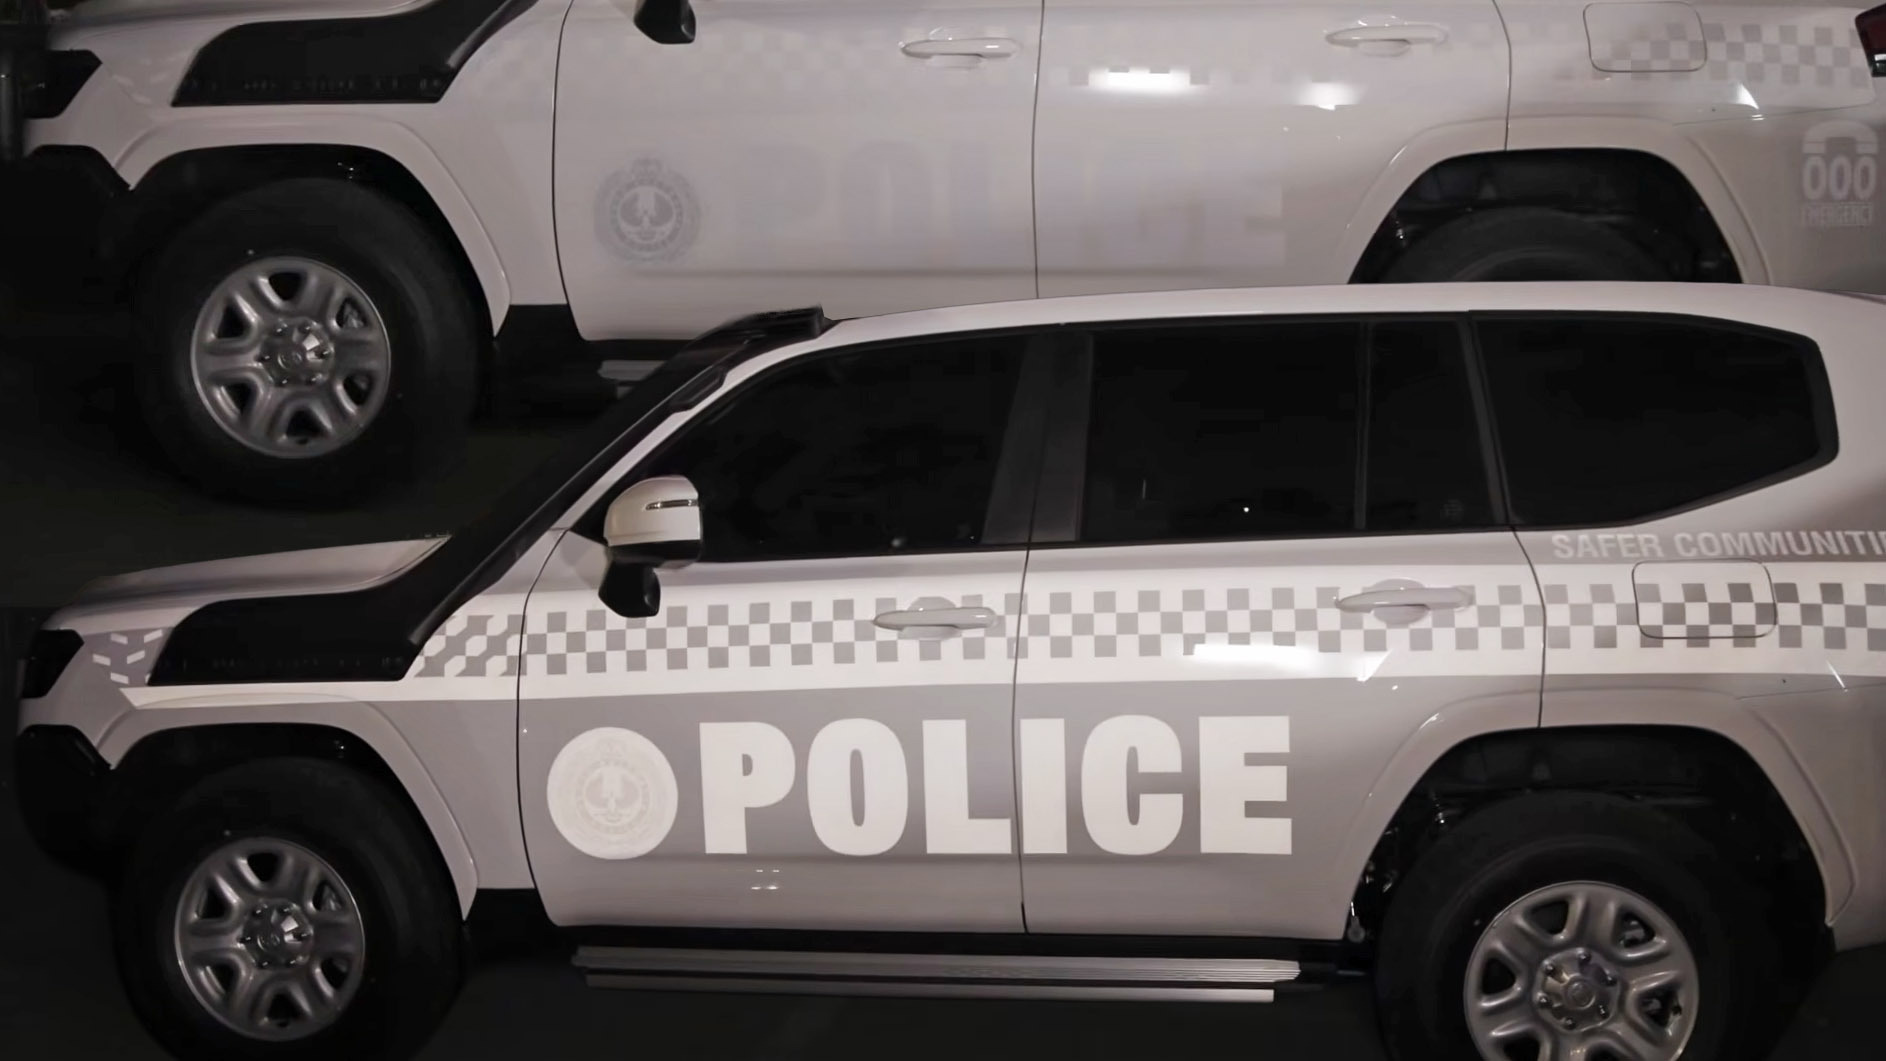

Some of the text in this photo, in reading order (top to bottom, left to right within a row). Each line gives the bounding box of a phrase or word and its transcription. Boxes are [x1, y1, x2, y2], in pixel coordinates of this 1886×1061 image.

[1802, 154, 1877, 201] 000
[1552, 533, 1664, 558] SAFER
[699, 714, 1292, 856] POLICE
